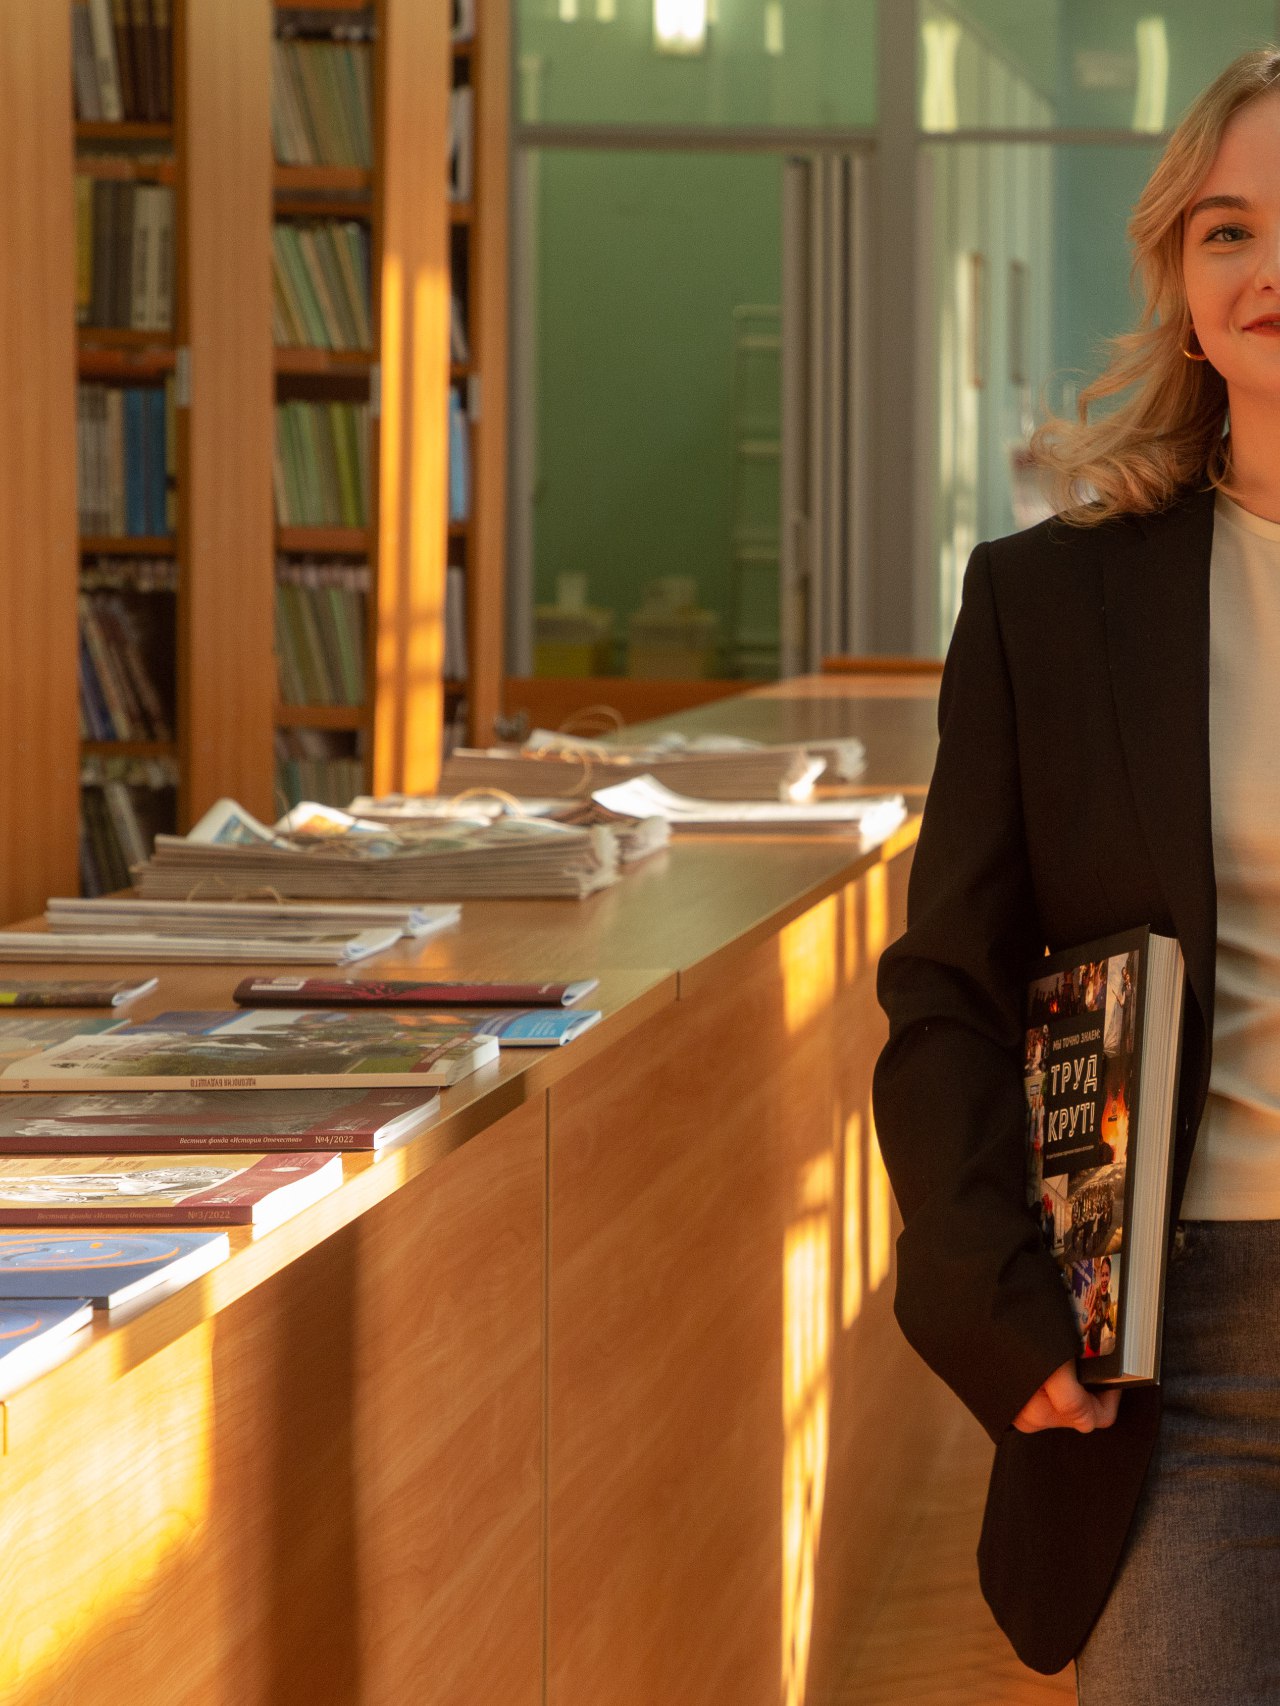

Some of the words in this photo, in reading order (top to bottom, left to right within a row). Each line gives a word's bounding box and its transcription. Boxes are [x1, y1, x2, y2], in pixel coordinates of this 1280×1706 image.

[1051, 1054, 1098, 1096] ТРУД
[1047, 1102, 1096, 1143] КРУТ!
[179, 1137, 207, 1145] Вестник
[208, 1137, 229, 1146] фонда
[229, 1136, 262, 1145] «История
[263, 1136, 303, 1144] Отечества»
[315, 1135, 354, 1144] №4/2022
[37, 1212, 68, 1220] Вестник
[187, 1210, 231, 1220] №3/2022
